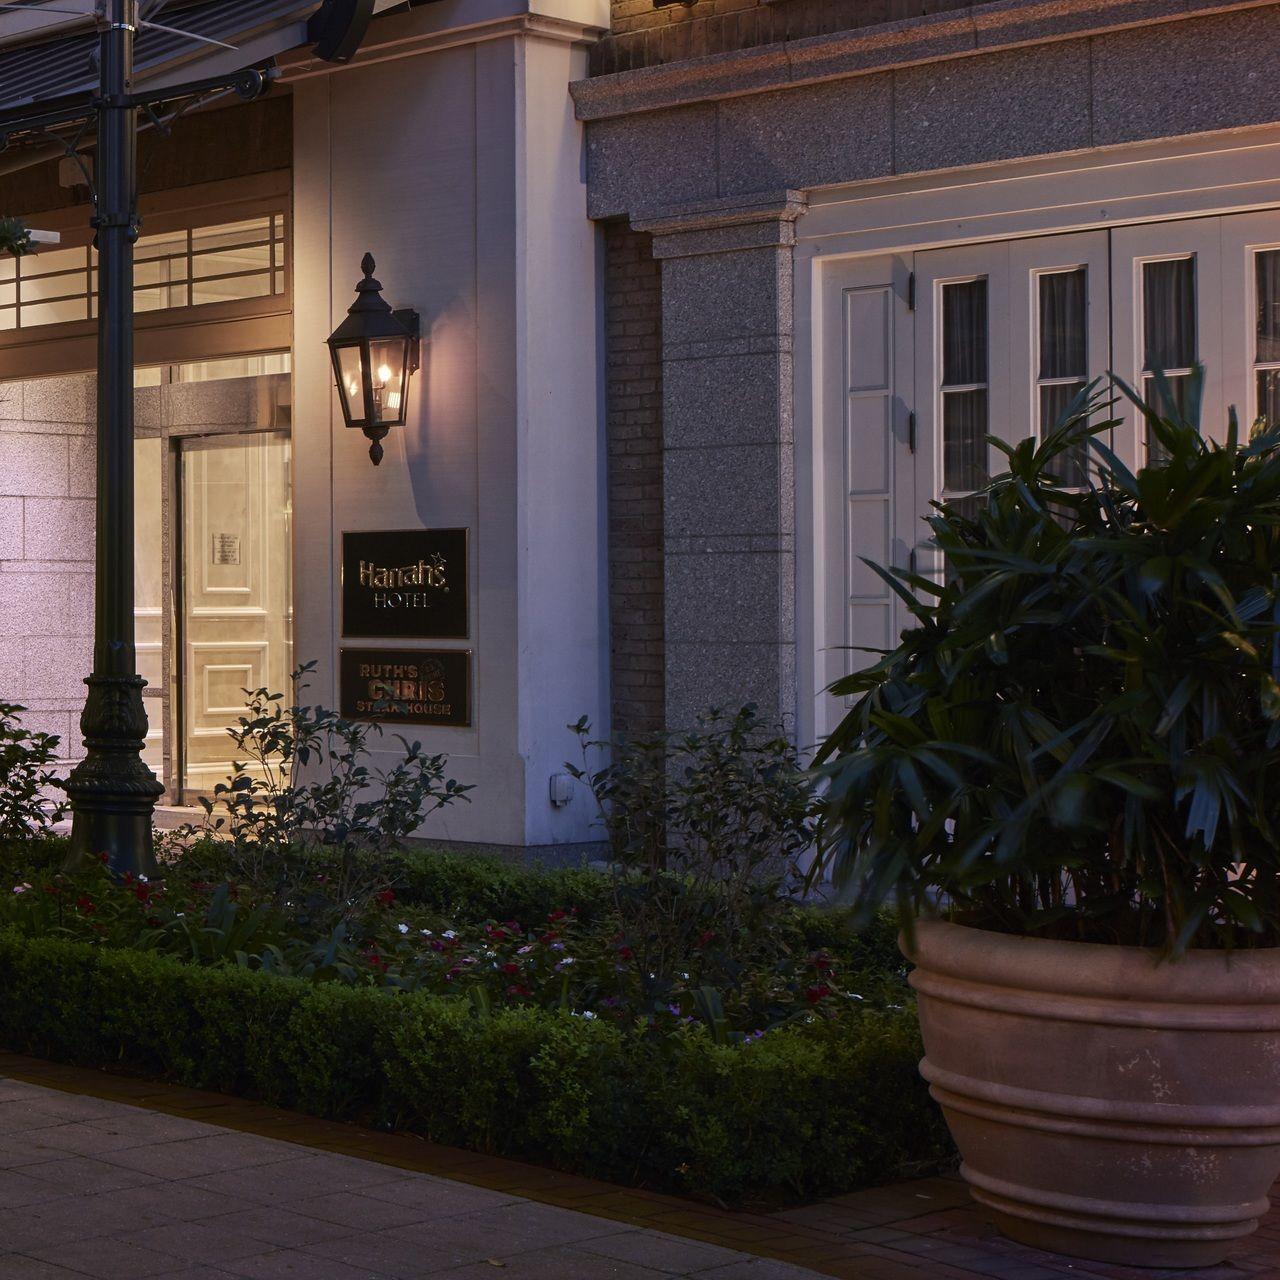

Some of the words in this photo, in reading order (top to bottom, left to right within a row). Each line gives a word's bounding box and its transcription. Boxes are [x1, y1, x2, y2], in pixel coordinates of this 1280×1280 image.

[374, 592, 431, 608] HOTEL
[359, 664, 418, 678] RUTH'S
[355, 700, 400, 713] STAK
